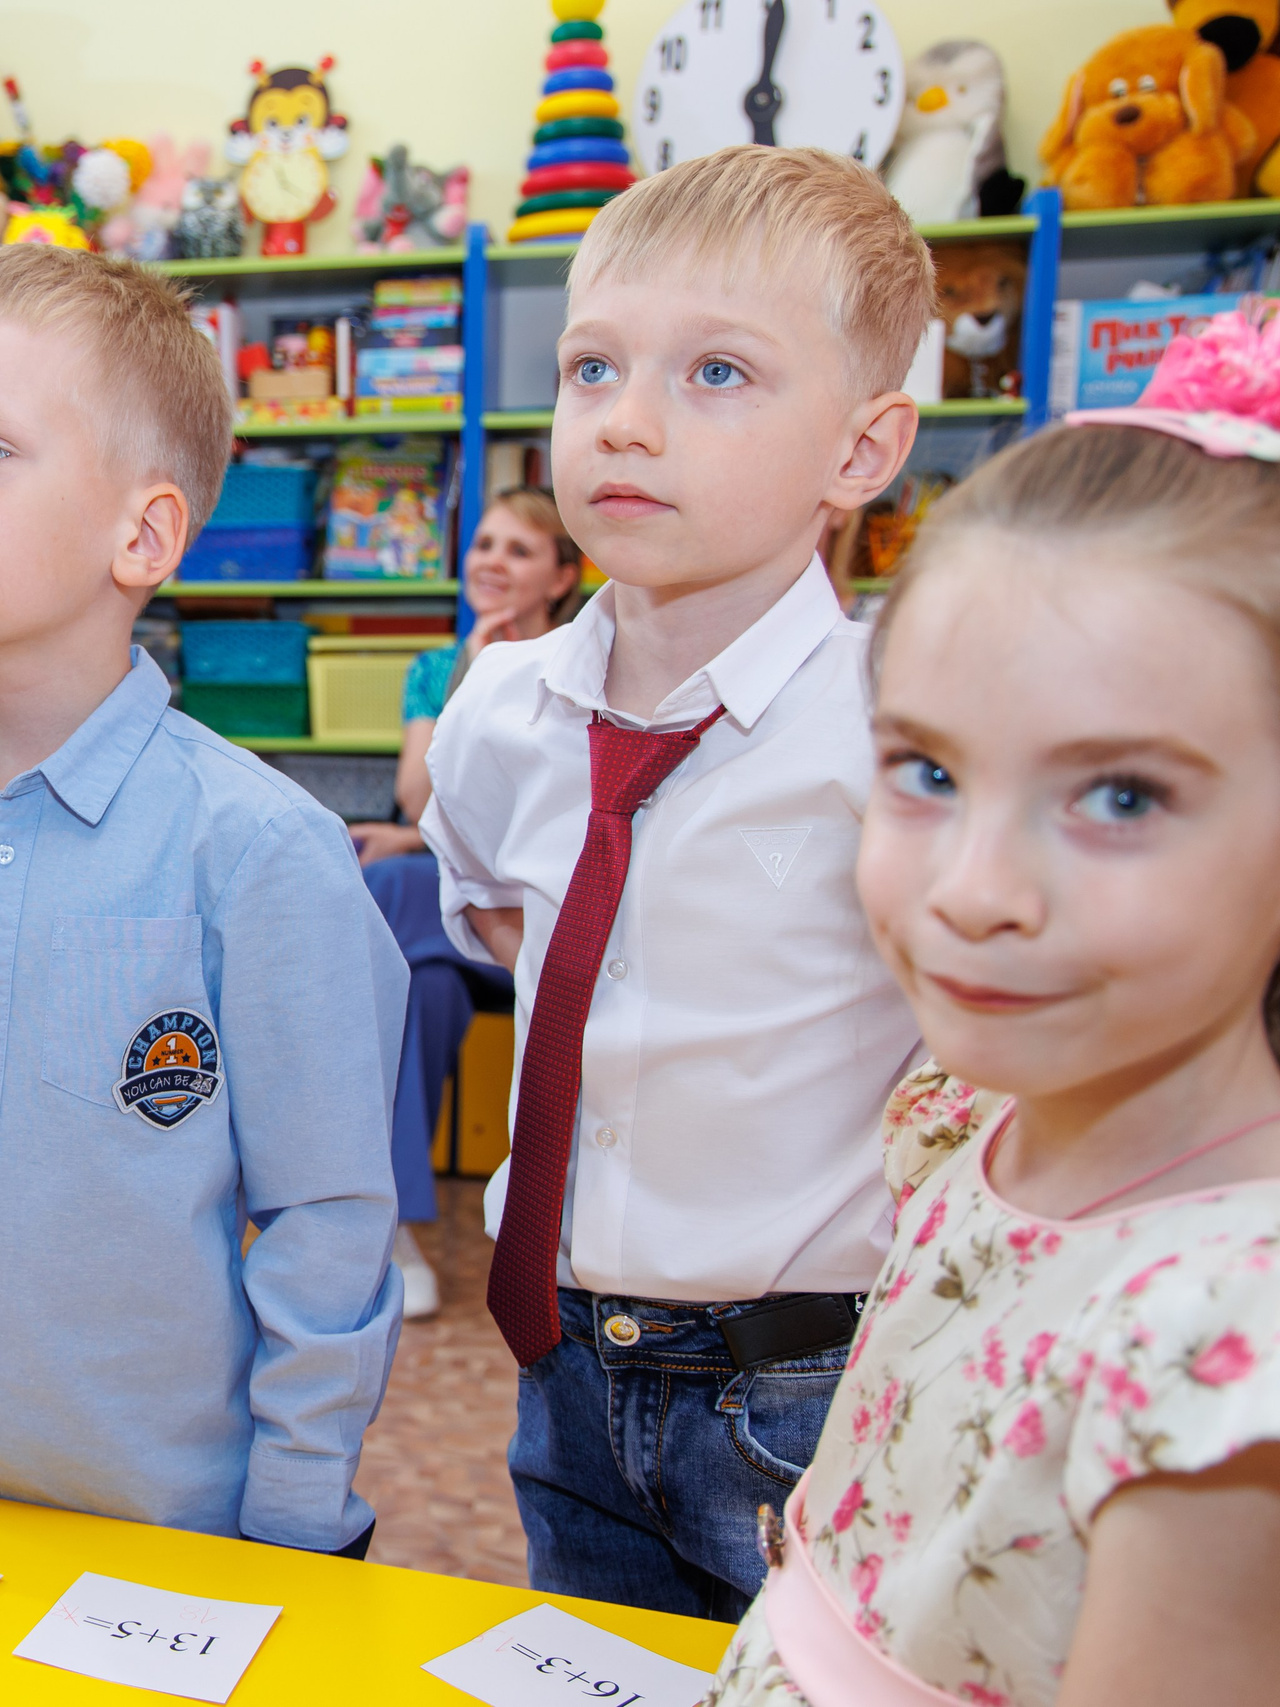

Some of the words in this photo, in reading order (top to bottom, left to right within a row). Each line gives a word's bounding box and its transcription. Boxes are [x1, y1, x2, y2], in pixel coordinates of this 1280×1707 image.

[698, 0, 723, 30] 11
[858, 14, 874, 50] 2
[659, 35, 687, 72] 10
[645, 86, 660, 122] 9
[875, 69, 890, 105] 3
[128, 1014, 217, 1069] CHAMPION
[161, 1048, 184, 1057] NUMBER
[165, 1035, 179, 1066] 1
[123, 1081, 148, 1100] YOU
[149, 1076, 171, 1090] CAN
[173, 1074, 192, 1087] BE
[82, 1615, 221, 1656] 13+5=
[510, 1642, 646, 1707] 16+3=
